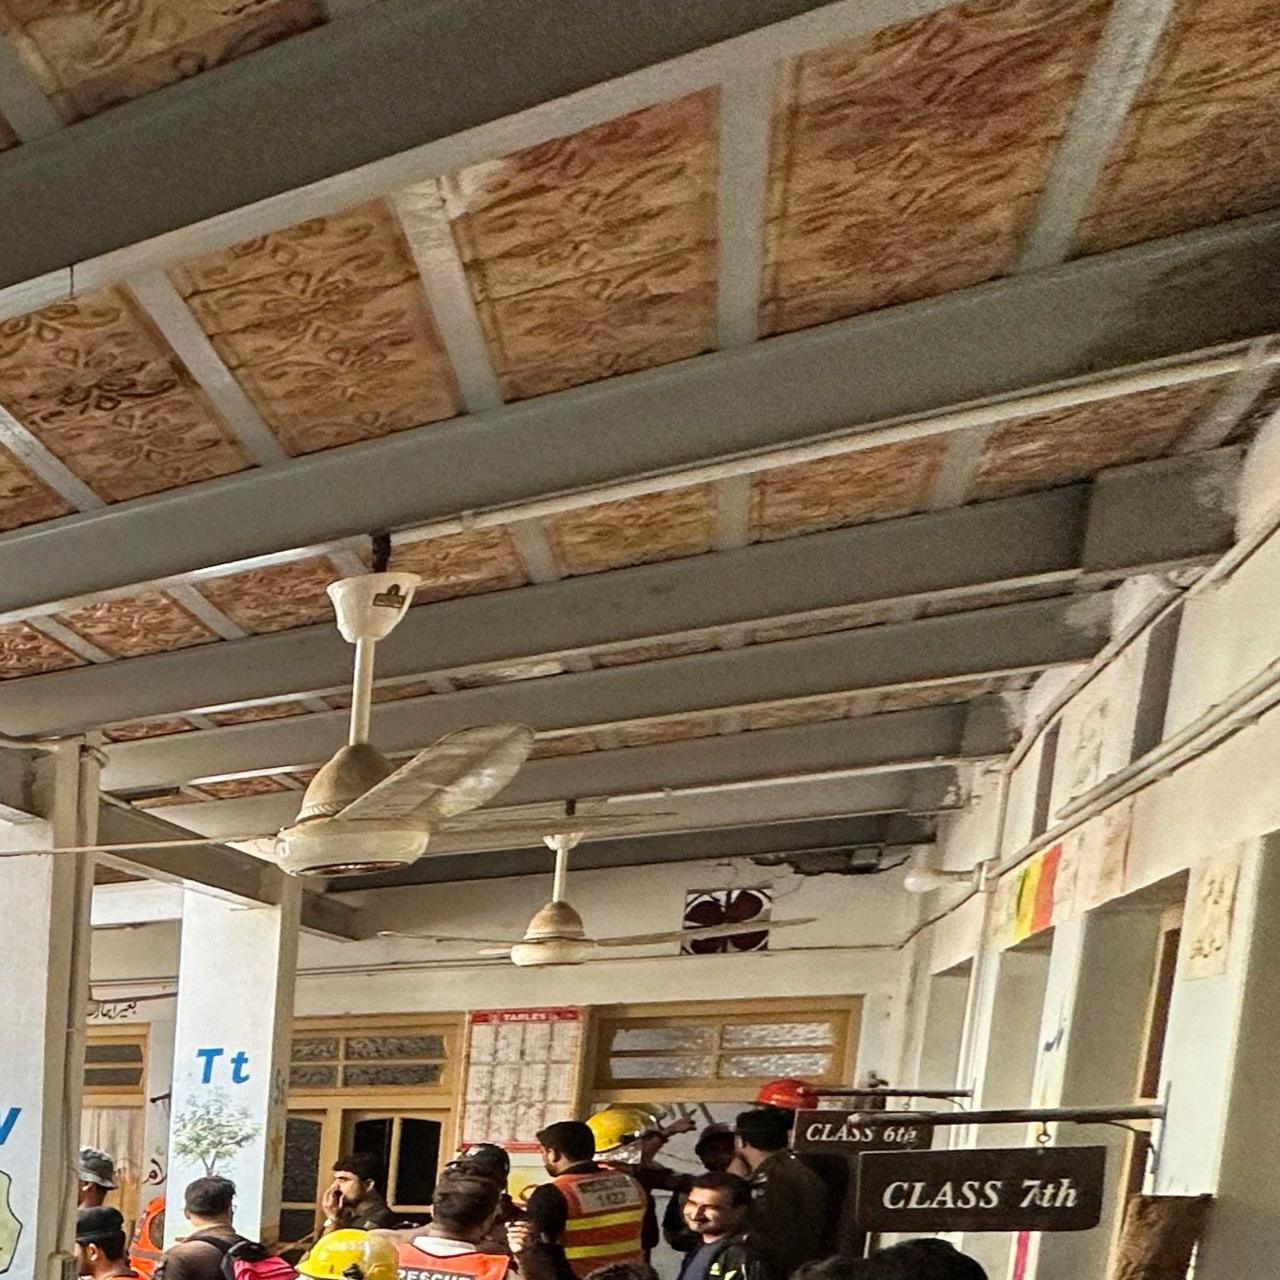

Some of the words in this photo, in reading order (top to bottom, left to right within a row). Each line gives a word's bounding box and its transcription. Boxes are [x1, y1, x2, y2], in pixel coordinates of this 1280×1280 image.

[804, 1122, 875, 1143] CLASS
[882, 1180, 1003, 1210] CLASS
[1019, 1177, 1078, 1209] 7th
